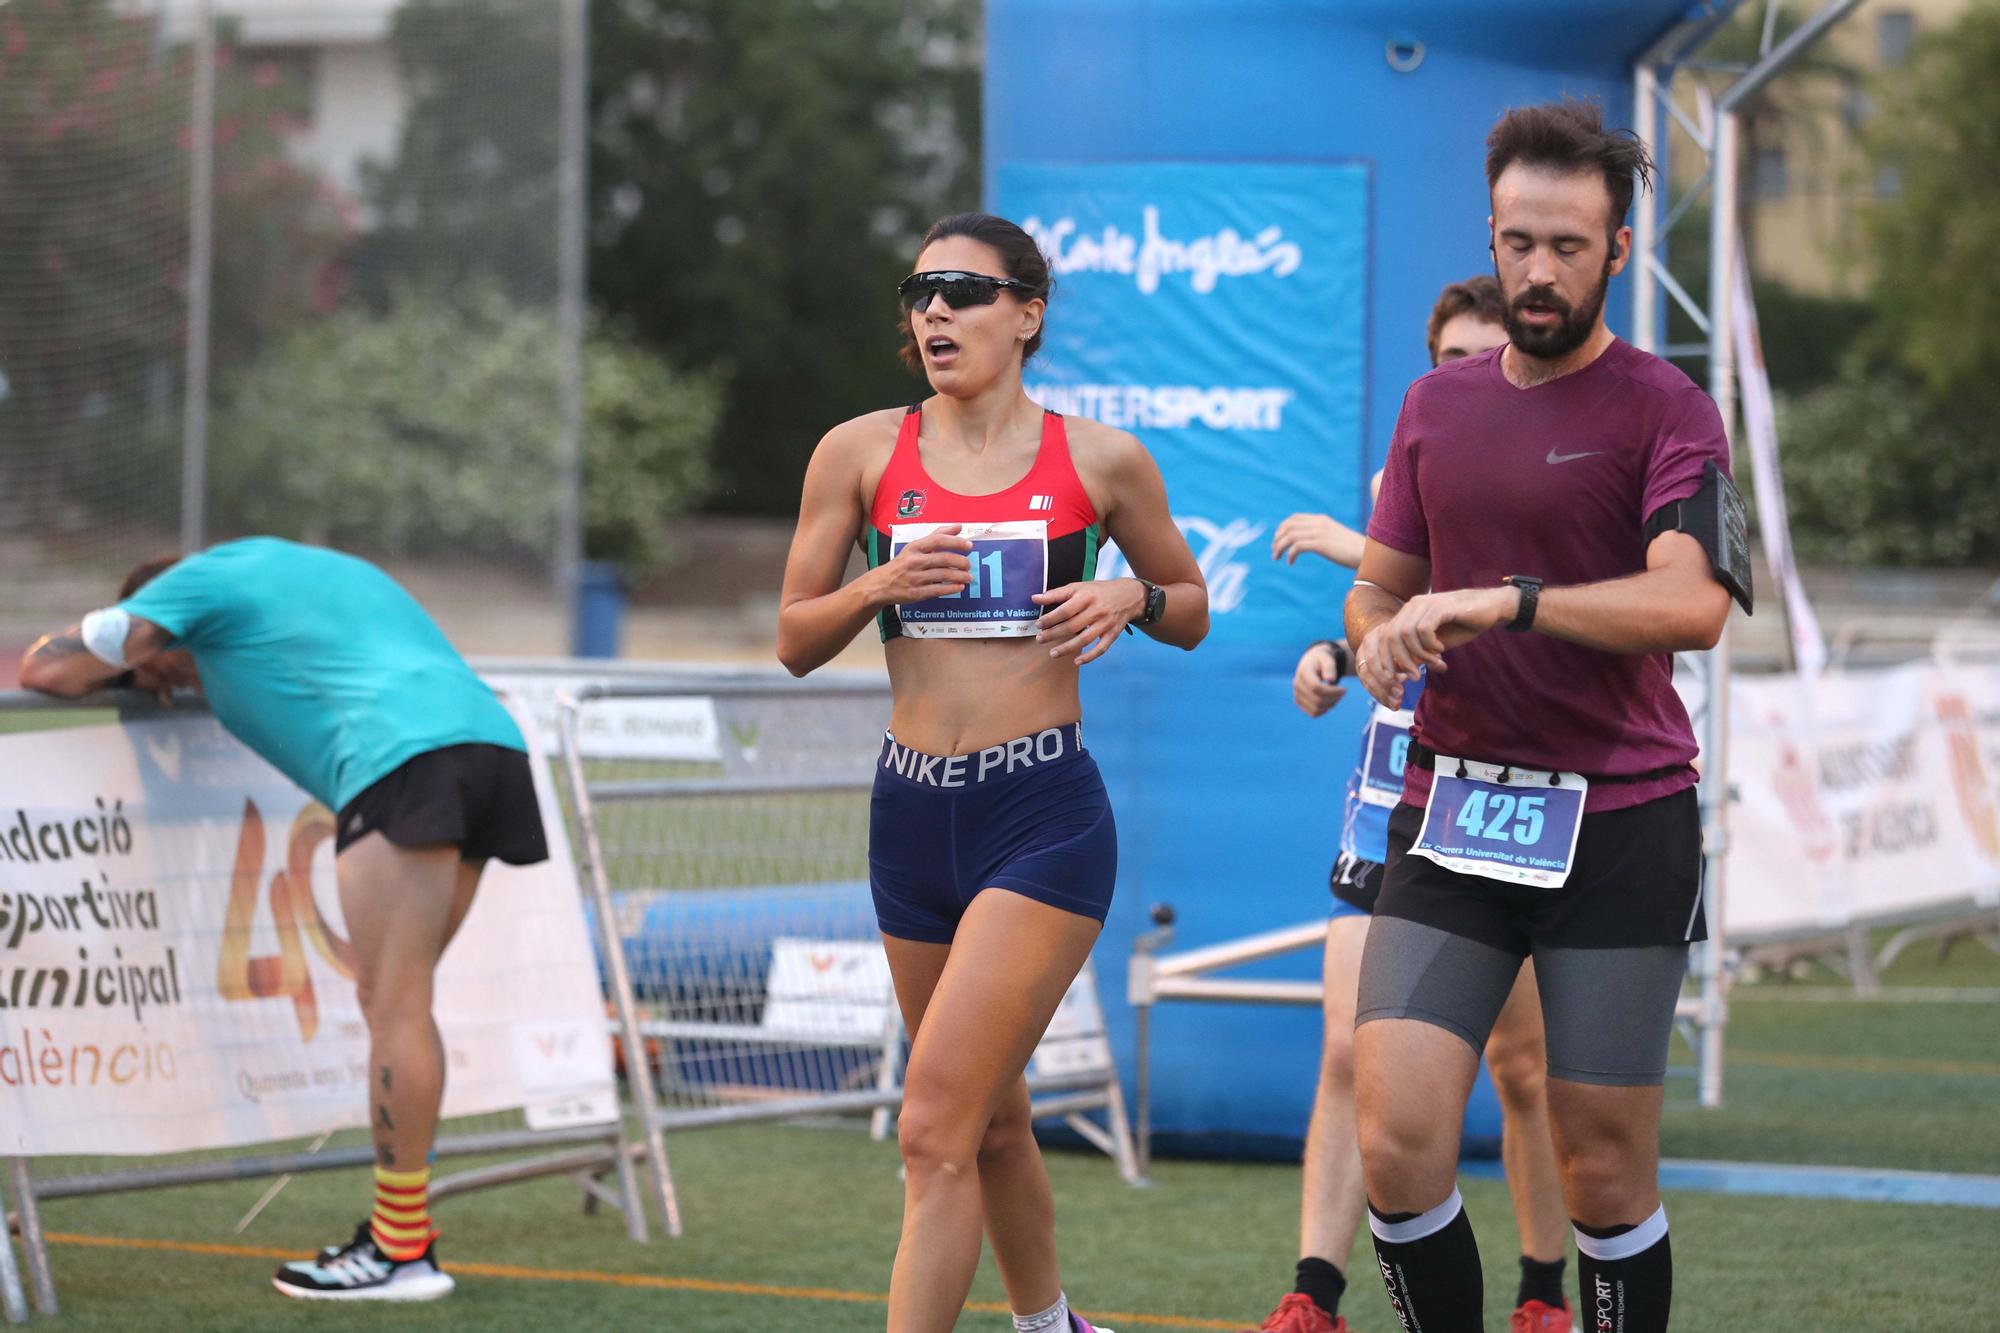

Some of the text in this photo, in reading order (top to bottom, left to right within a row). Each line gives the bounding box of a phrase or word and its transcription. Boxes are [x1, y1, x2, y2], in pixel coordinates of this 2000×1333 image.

[938, 550, 1004, 599] 11
[902, 610, 912, 619] IX
[914, 610, 945, 619] Carrera
[947, 609, 991, 619] Universitat
[992, 609, 1005, 618] de
[884, 739, 969, 788] NIKE
[977, 727, 1064, 783] PRO
[1456, 789, 1546, 846] 425
[1433, 844, 1464, 855] Carrera
[1466, 847, 1514, 862] Universitat
[1515, 855, 1527, 865] de
[1529, 856, 1566, 870] València
